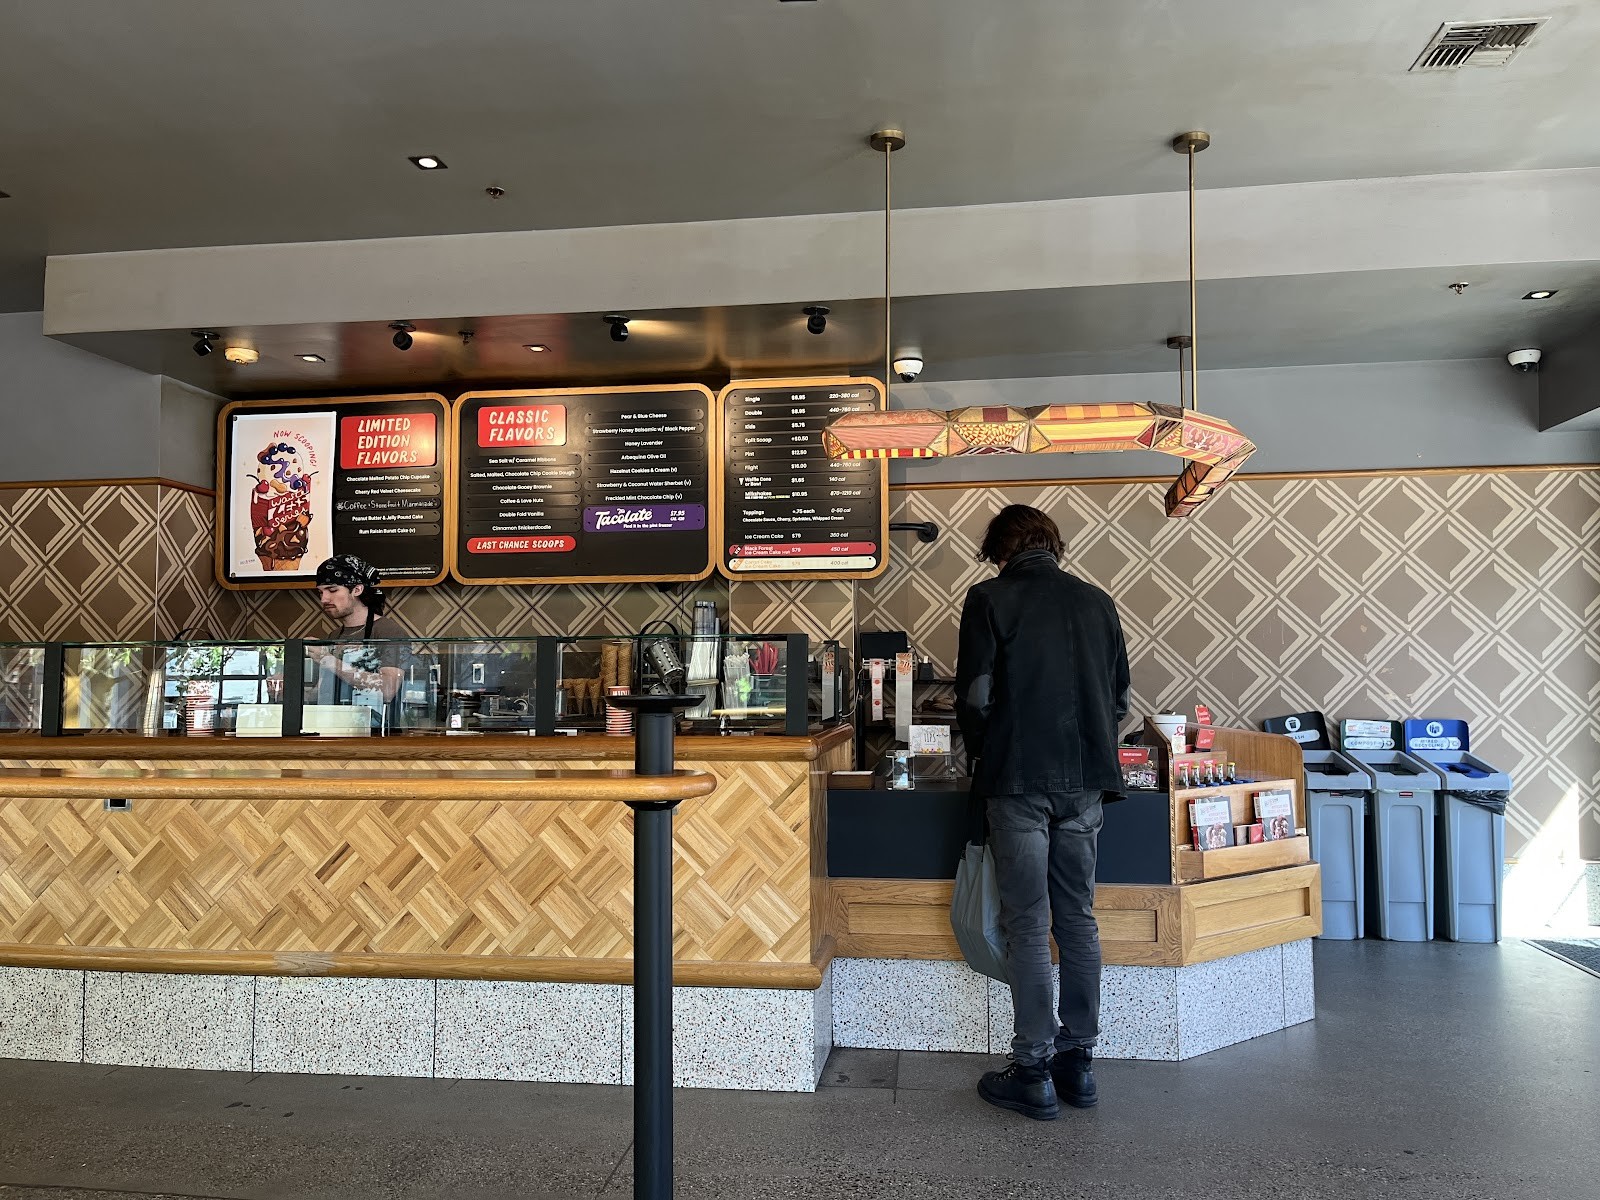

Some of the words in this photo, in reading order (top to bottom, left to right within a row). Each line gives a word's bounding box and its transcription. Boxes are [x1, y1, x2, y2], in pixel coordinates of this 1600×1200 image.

[489, 410, 549, 425] CLASSIC
[358, 418, 410, 433] LIMITED
[273, 430, 292, 438] NOW
[358, 434, 410, 449] EDITION
[489, 427, 555, 442] FLAVORS
[294, 433, 317, 467] SCOOPING!
[357, 450, 418, 465] FLAVORS
[343, 501, 367, 510] Coffee
[595, 508, 652, 530] Tacolate
[477, 541, 496, 549] LAST
[499, 540, 528, 549] CHANCE
[532, 539, 564, 548] SCOOPS
